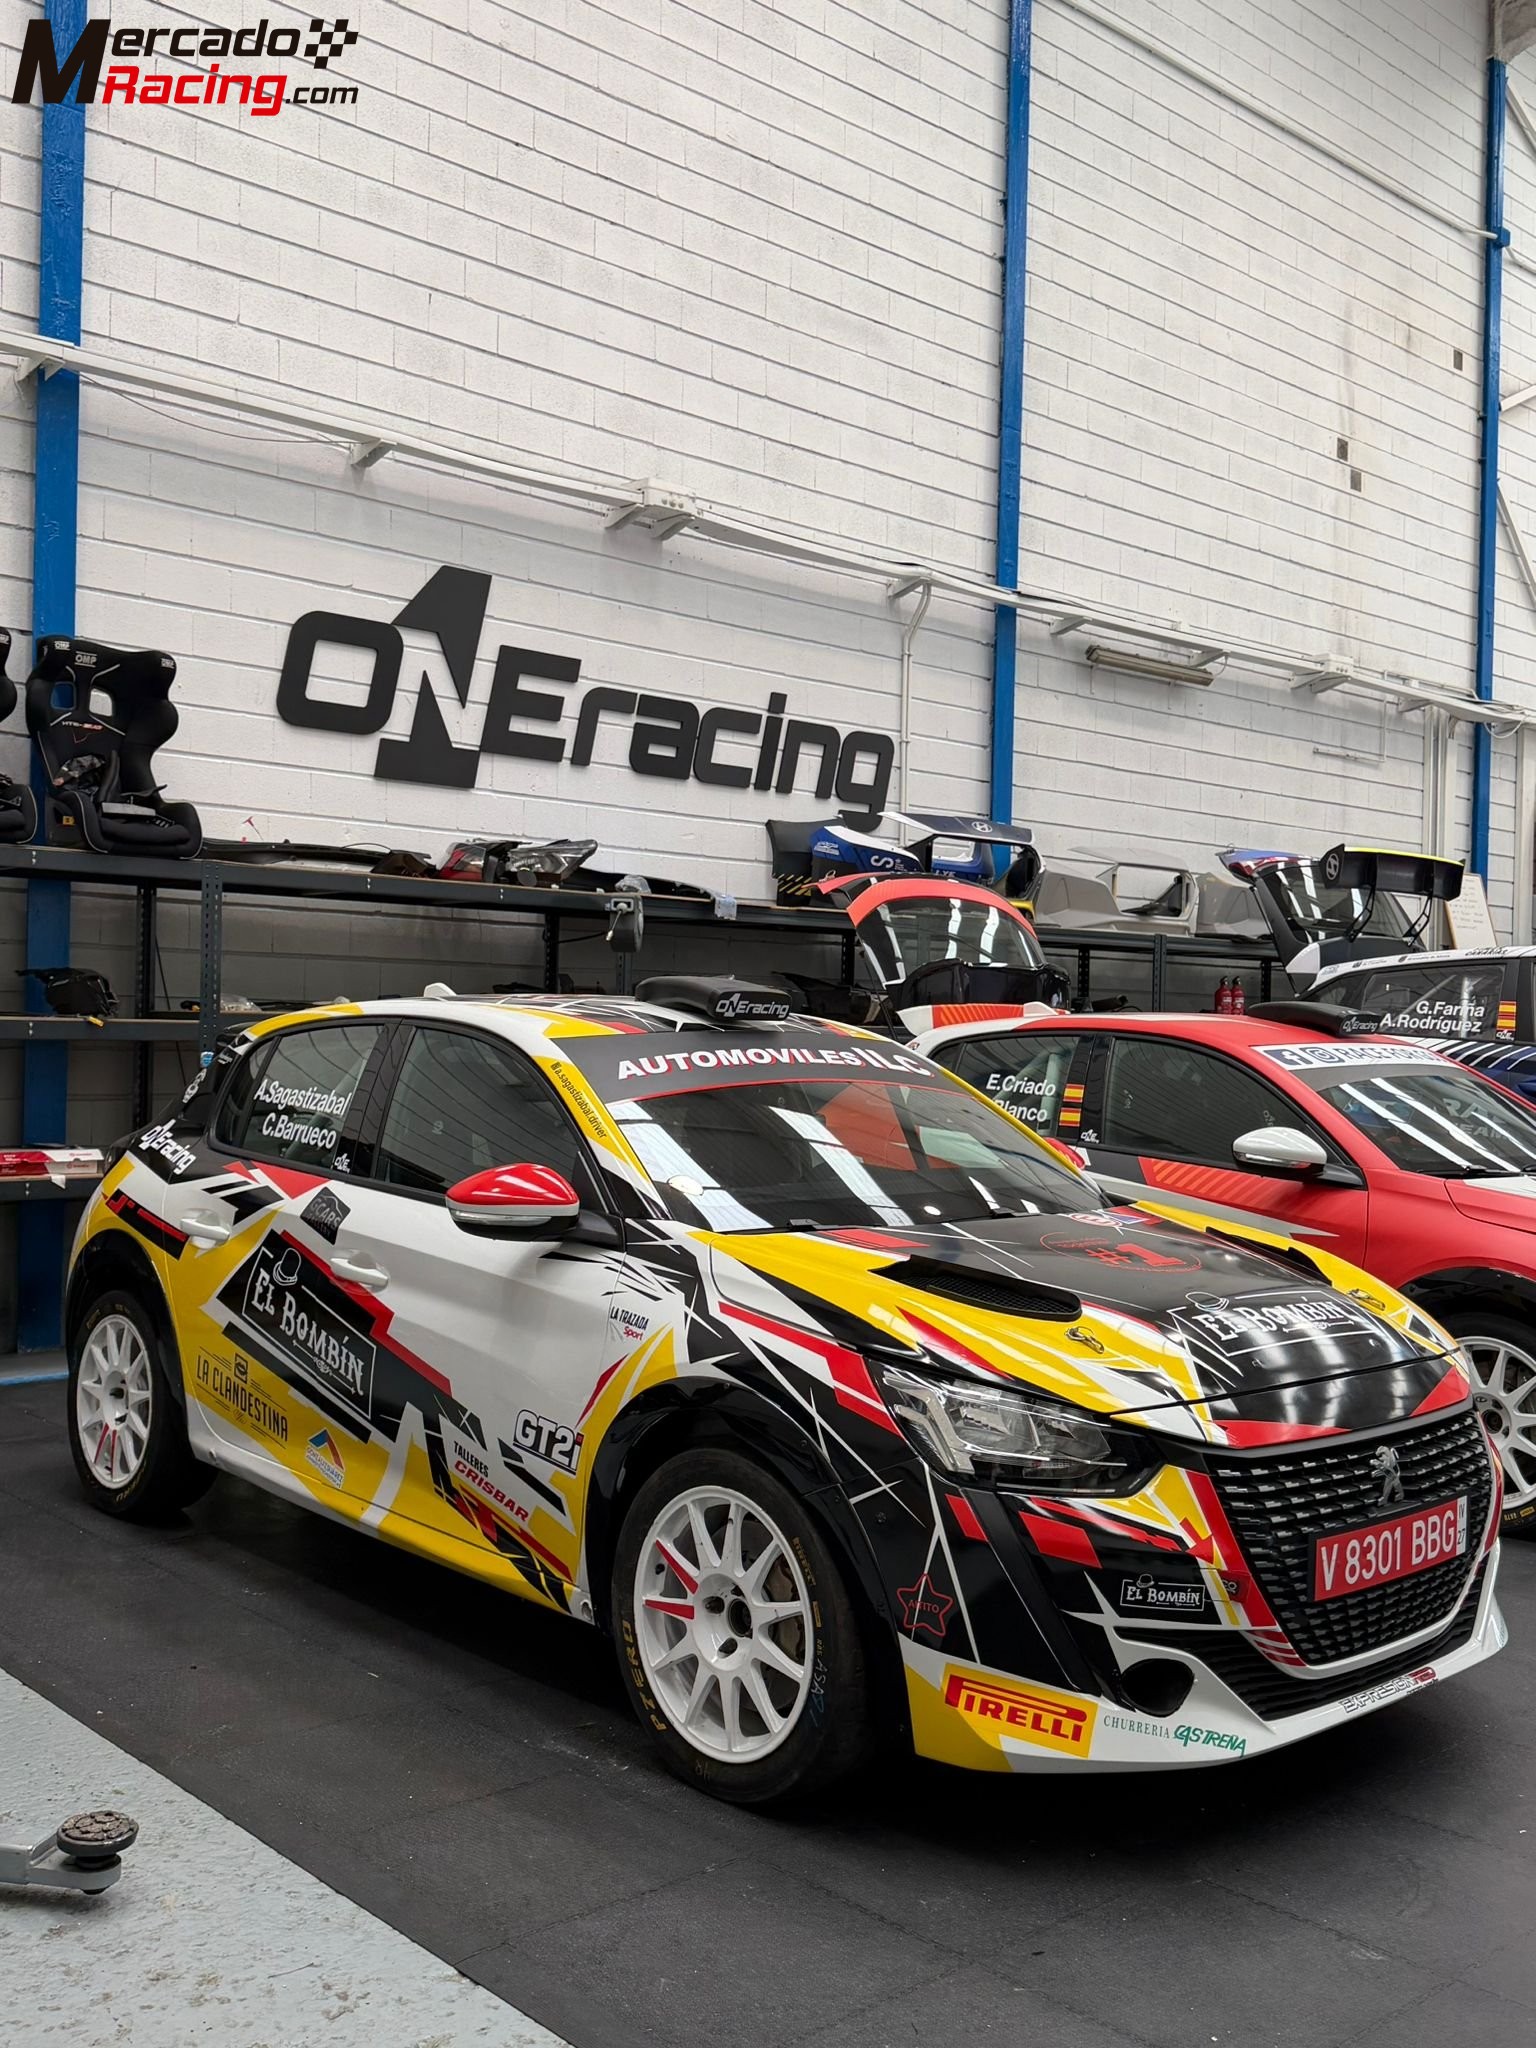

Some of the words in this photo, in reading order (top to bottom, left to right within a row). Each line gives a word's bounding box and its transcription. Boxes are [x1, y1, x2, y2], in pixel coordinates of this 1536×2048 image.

[75, 654, 97, 665] OMP
[1380, 1013, 1482, 1033] A.Rodríguez
[1416, 1001, 1485, 1017] G.Fariña
[618, 1048, 861, 1080] AUTOMOVILES
[254, 1079, 352, 1118] A.Sagastizabal
[986, 1073, 1056, 1096] E.Criado
[262, 1113, 337, 1149] C.Barrueco
[610, 1306, 619, 1320] LA
[619, 1309, 649, 1330] TRAZADA
[624, 1326, 643, 1341] Sport
[196, 1355, 209, 1385] LA
[212, 1369, 288, 1442] CLANDESTINA
[454, 1440, 489, 1478] TALLERES
[454, 1460, 530, 1522] CRISBAR
[1321, 1543, 1339, 1591] V
[1345, 1526, 1402, 1585] 8301
[1411, 1510, 1455, 1566] BBG
[1457, 1528, 1465, 1546] 27
[945, 1674, 1087, 1743] PIRELLI
[1104, 1714, 1170, 1739] CHURRERIA
